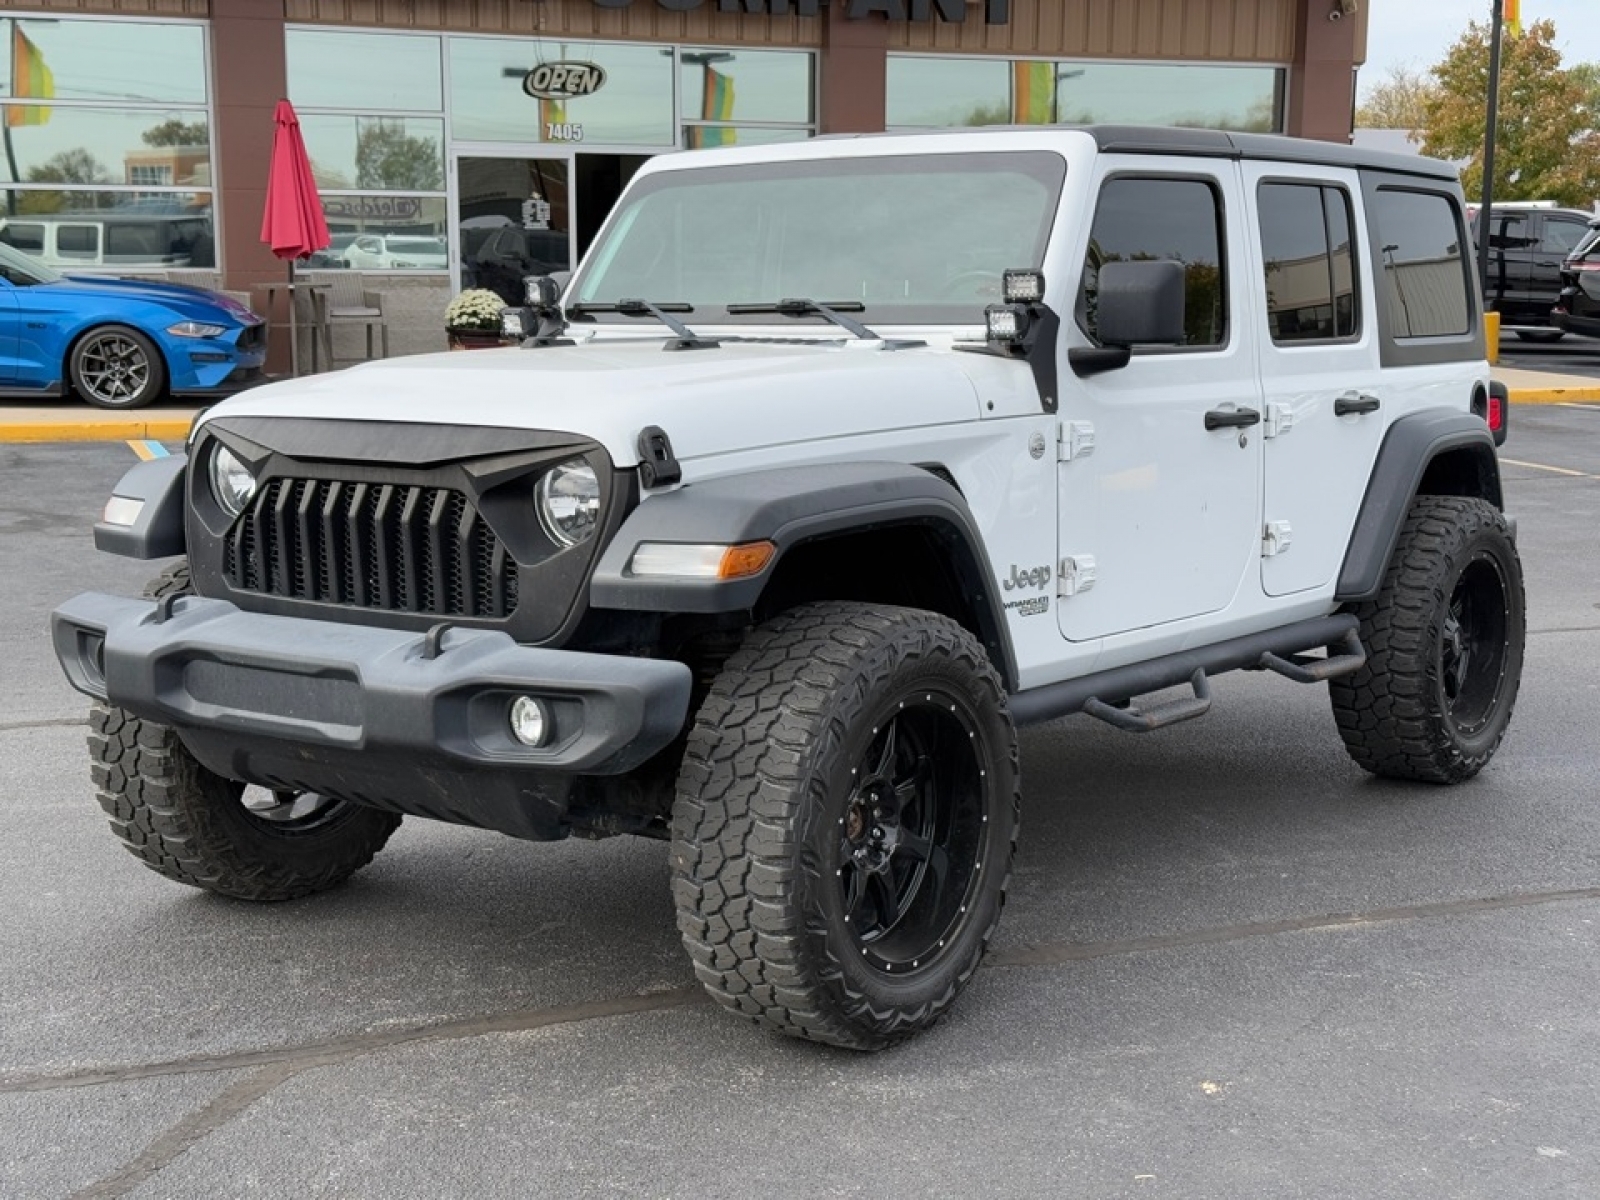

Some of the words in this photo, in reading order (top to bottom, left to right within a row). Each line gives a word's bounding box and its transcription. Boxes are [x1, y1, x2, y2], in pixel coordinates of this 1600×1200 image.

[532, 66, 600, 93] OPEN
[546, 122, 583, 141] 7405
[1003, 564, 1051, 591] Jeep
